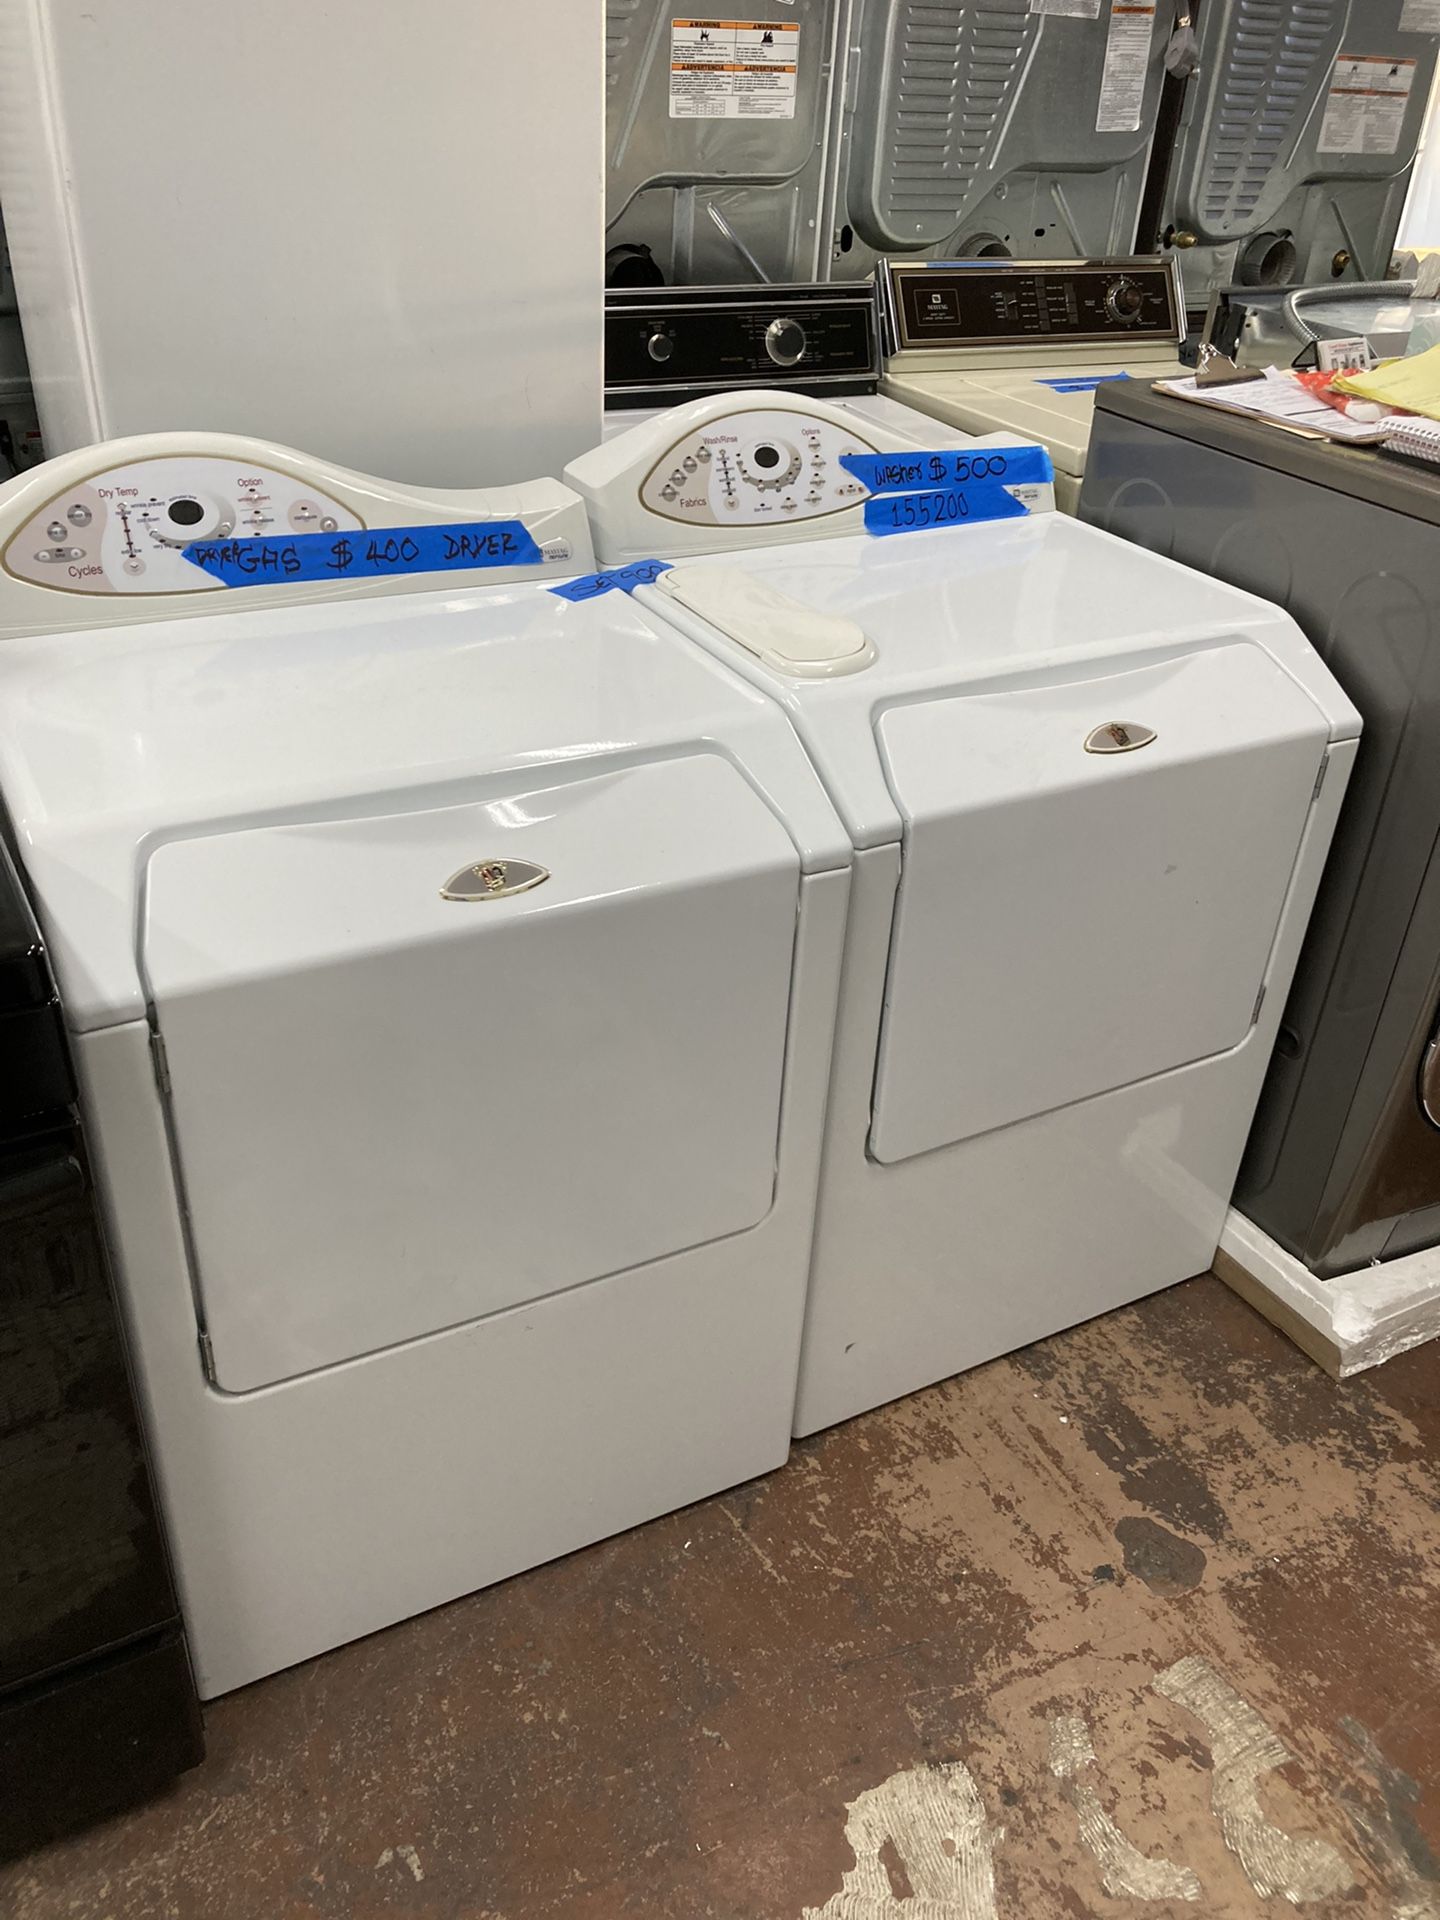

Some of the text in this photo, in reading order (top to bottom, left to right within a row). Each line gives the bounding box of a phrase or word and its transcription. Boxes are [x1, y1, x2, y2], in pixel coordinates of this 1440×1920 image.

[694, 21, 721, 29] WARNING
[757, 23, 783, 31] WARNING
[702, 436, 738, 446] Wash/Rinse
[929, 455, 947, 483] $
[954, 455, 1007, 483] 500
[237, 478, 263, 488] Option
[98, 487, 139, 499] Dry Temp
[680, 498, 707, 509] Fabrics
[891, 492, 969, 527] 155200
[238, 543, 302, 574] GAS
[326, 538, 353, 573] $
[366, 536, 420, 567] 400
[443, 533, 518, 560] DRYER
[68, 564, 104, 579] Cycles
